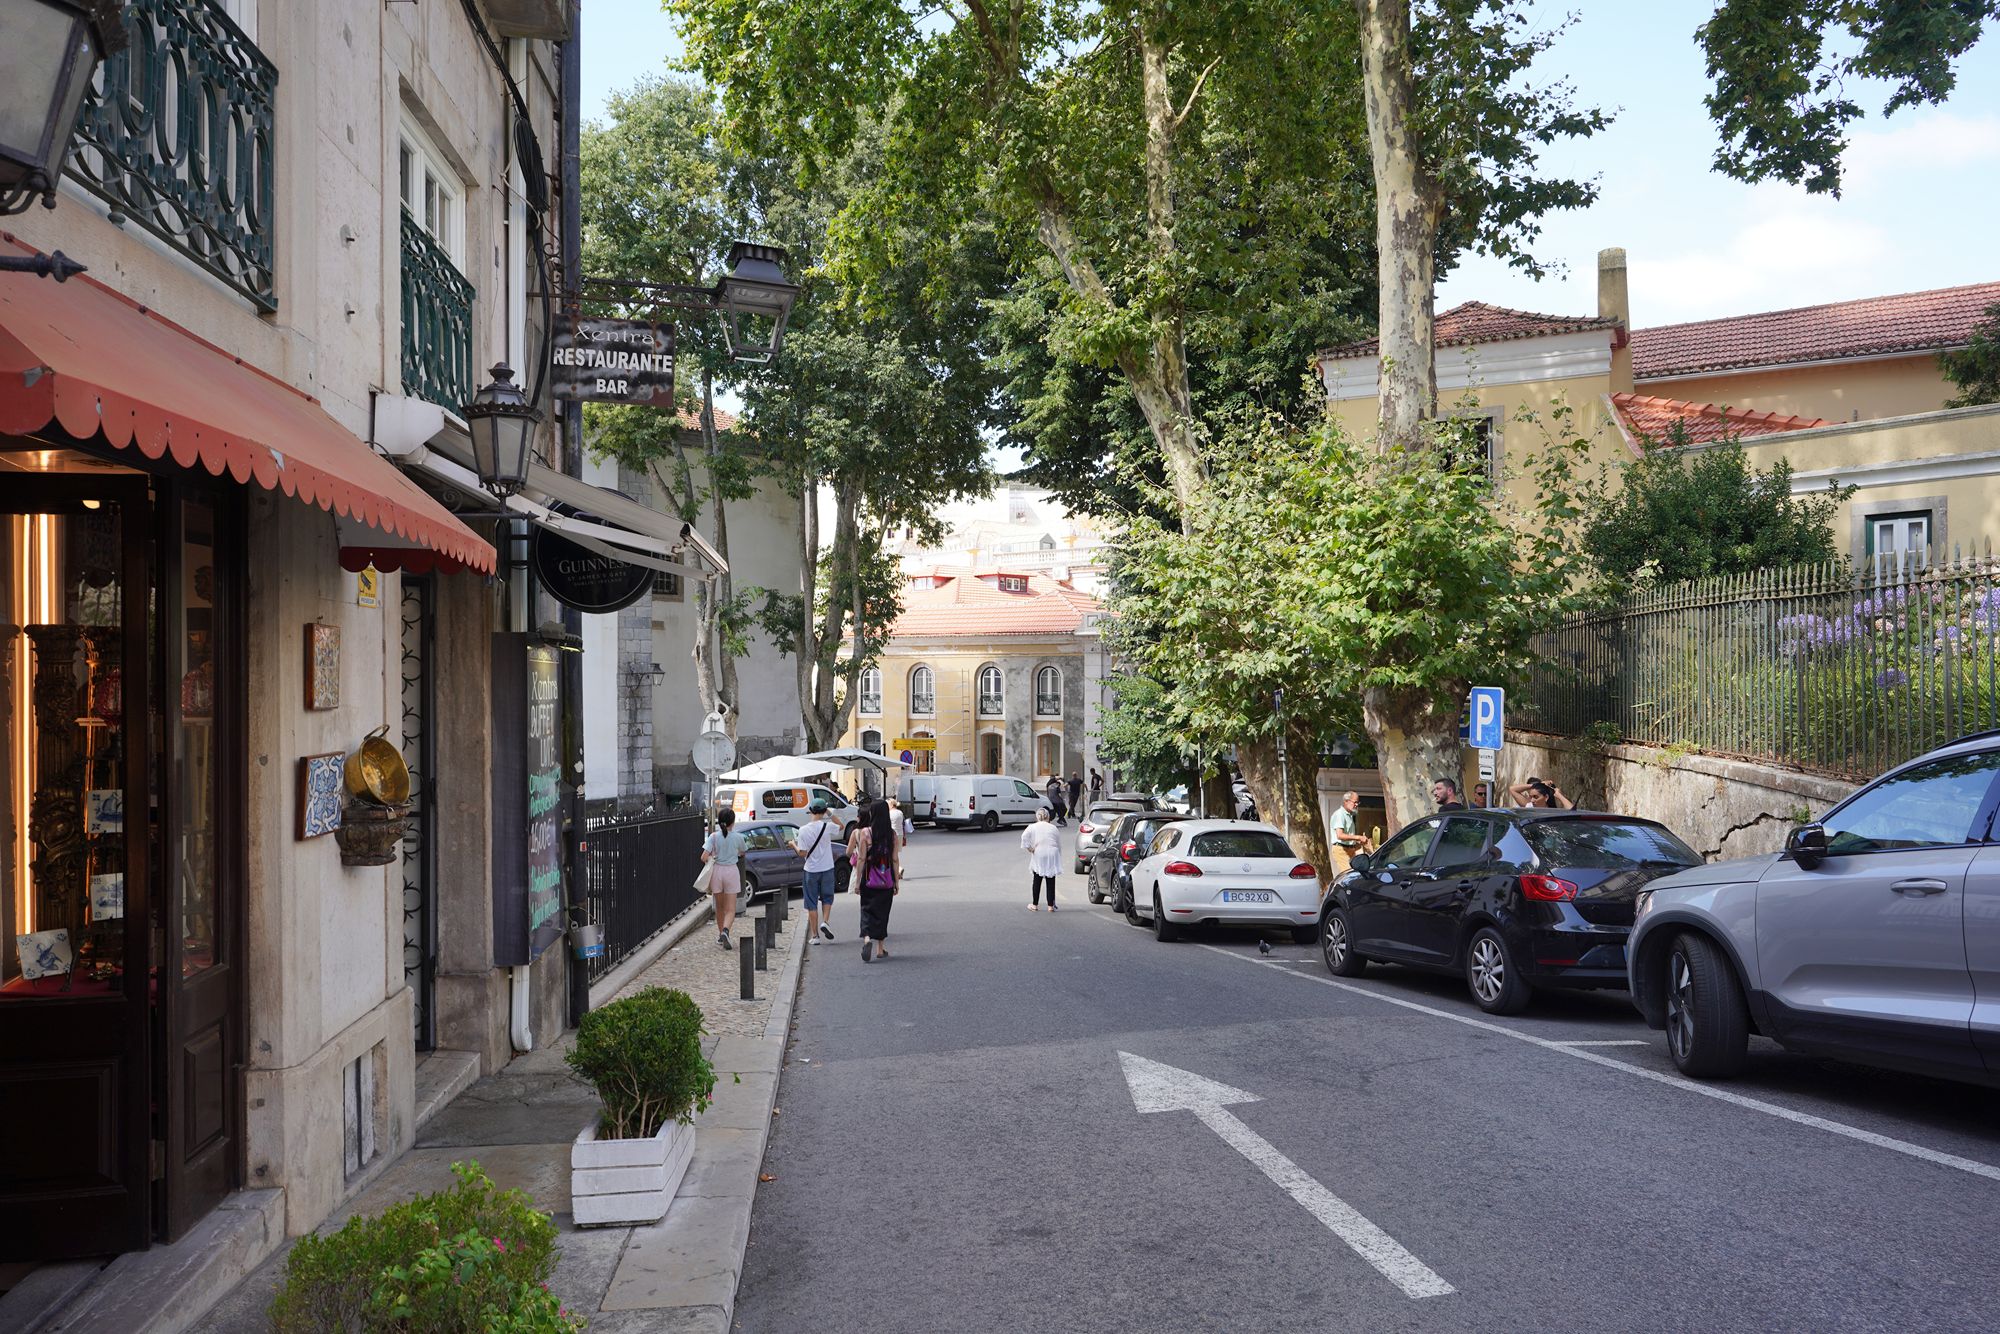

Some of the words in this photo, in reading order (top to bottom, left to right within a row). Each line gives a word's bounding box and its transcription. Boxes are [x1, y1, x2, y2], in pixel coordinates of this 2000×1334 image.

[574, 325, 655, 345] Xentra
[553, 347, 673, 373] RESTAURANTE
[596, 378, 628, 395] BAR
[531, 671, 558, 701] Xentra
[530, 703, 554, 738] BUFFET
[1476, 693, 1495, 742] P
